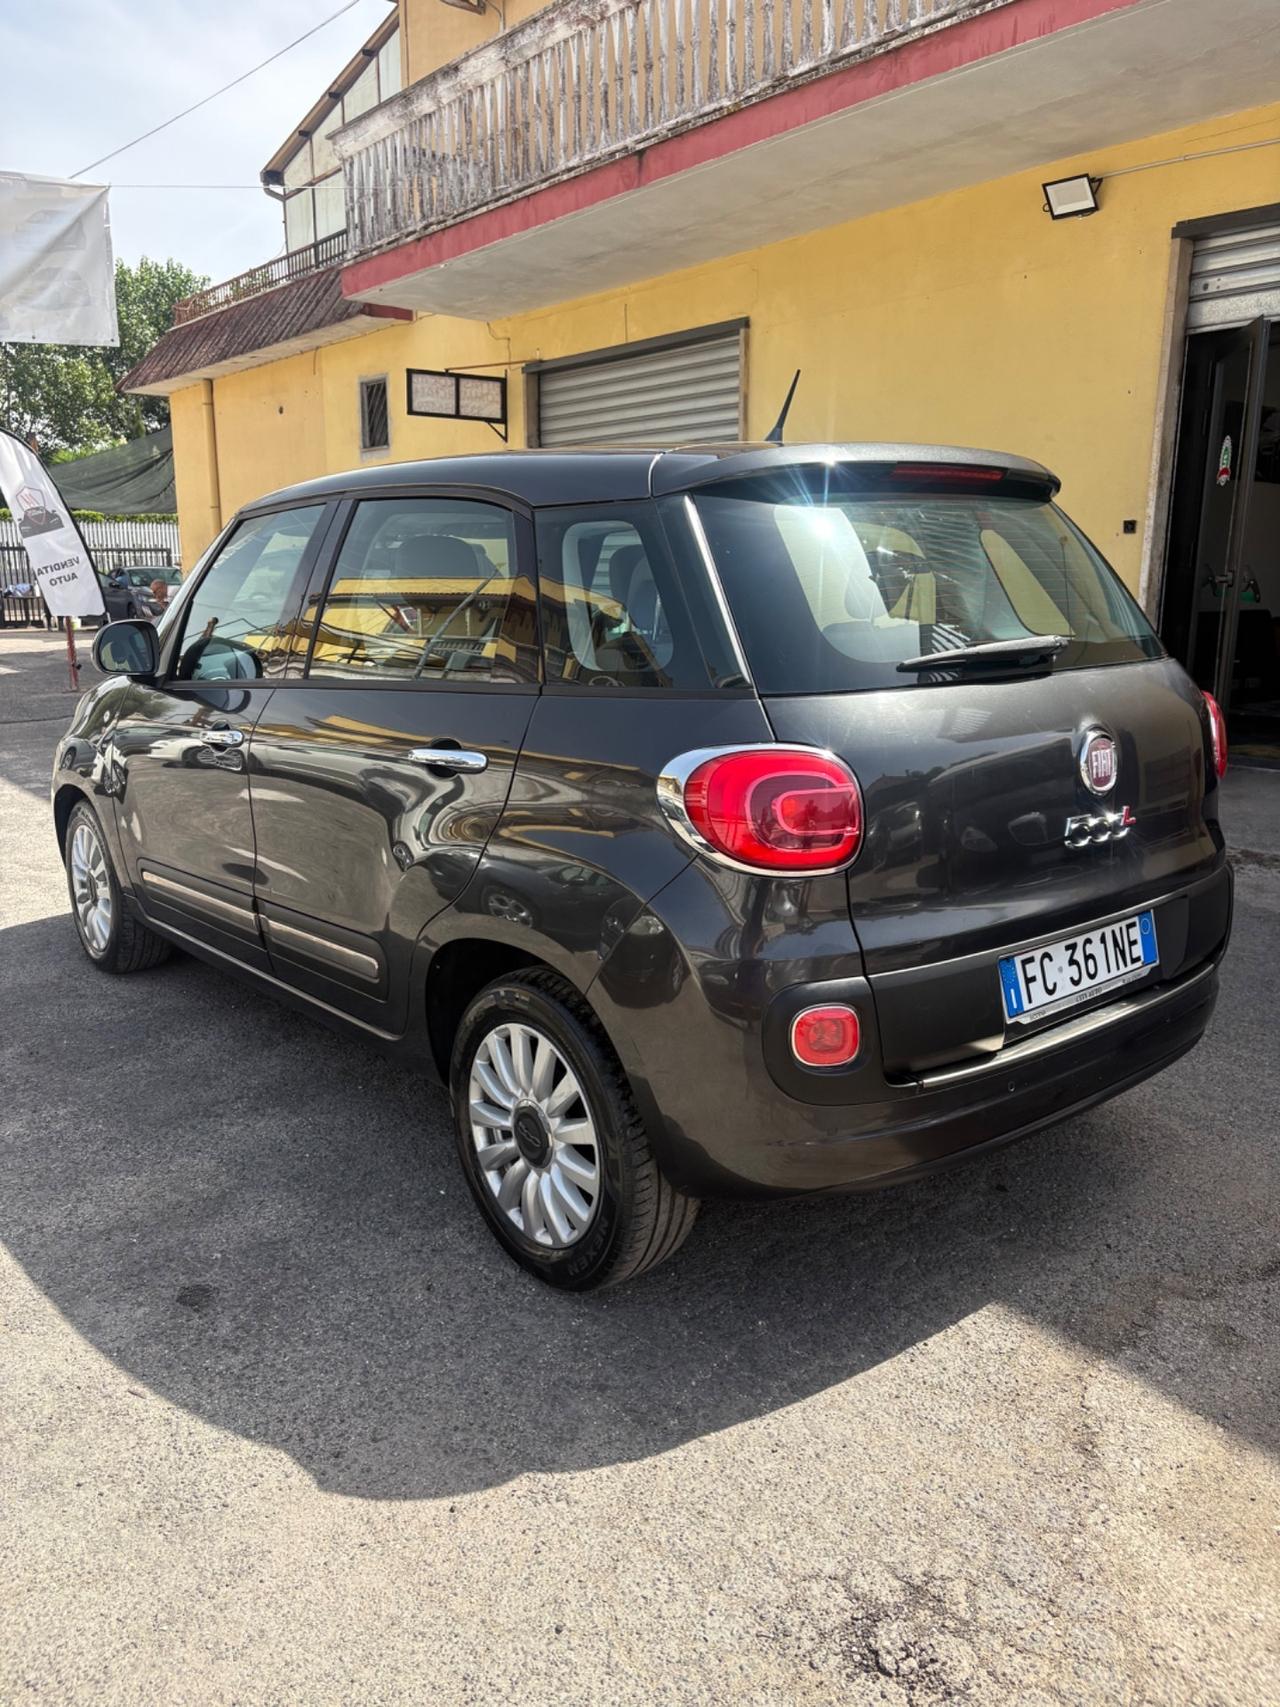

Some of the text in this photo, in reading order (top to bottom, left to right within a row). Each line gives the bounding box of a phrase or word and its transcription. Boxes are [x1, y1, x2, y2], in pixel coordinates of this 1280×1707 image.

[1091, 749, 1112, 778] FIAT
[1020, 921, 1141, 1004] FC 361NE
